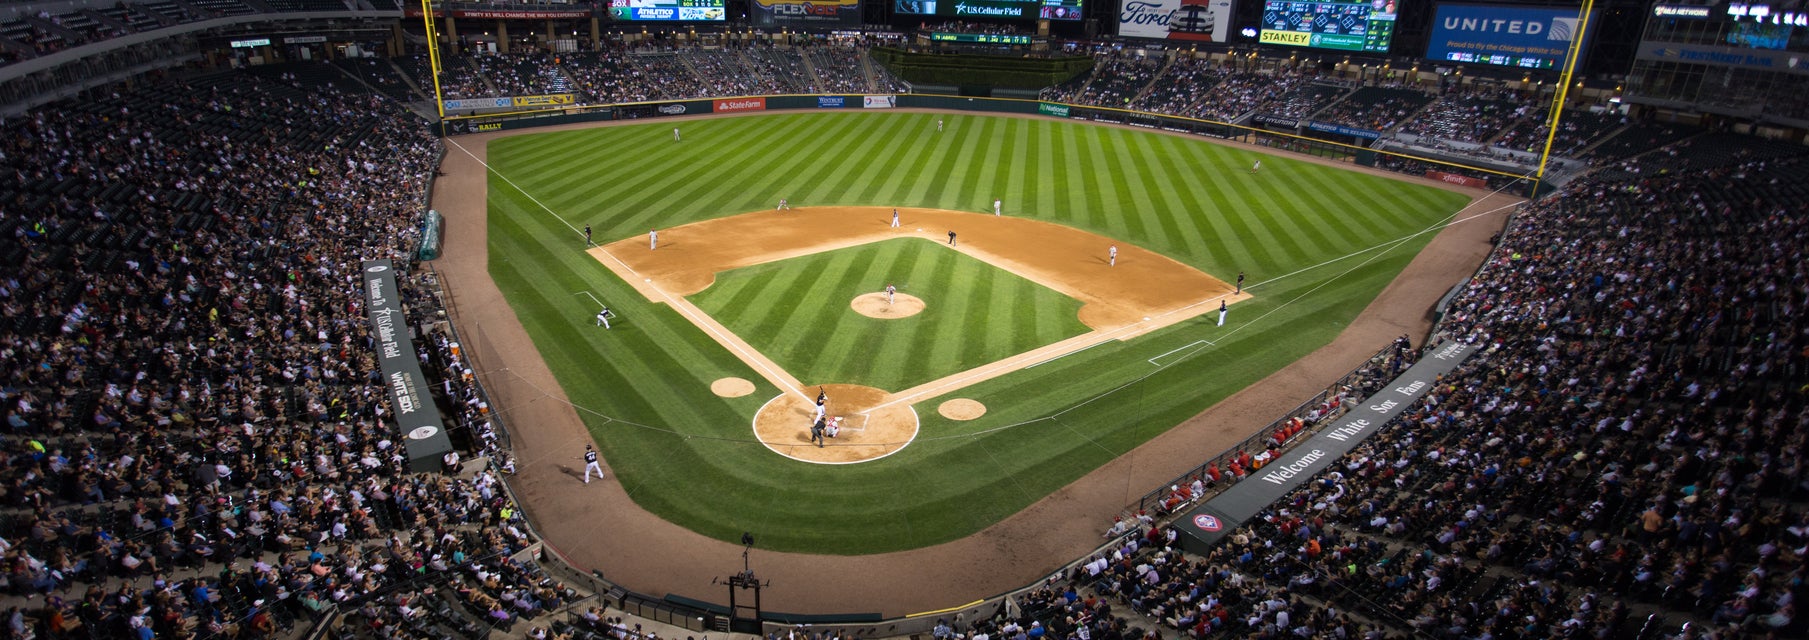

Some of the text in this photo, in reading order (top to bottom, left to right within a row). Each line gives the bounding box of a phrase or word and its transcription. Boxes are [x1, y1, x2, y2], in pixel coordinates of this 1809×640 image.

[774, 4, 839, 15] FLEXVOLT
[978, 6, 1003, 14] Cellular
[1120, 1, 1177, 26] Ford
[1677, 7, 1709, 16] NETWORK
[1444, 17, 1543, 35] UNITED
[1263, 32, 1307, 43] STANLEY
[1499, 45, 1525, 53] Chicago
[1527, 46, 1549, 54] White
[1045, 105, 1068, 113] National
[1266, 117, 1295, 126] HYUNDAI
[479, 123, 502, 131] RALLY
[1443, 174, 1466, 184] xfinity
[383, 342, 400, 358] Field
[390, 371, 415, 414] WHITE SOX
[1262, 379, 1426, 486] Welcome White Sox Fans
